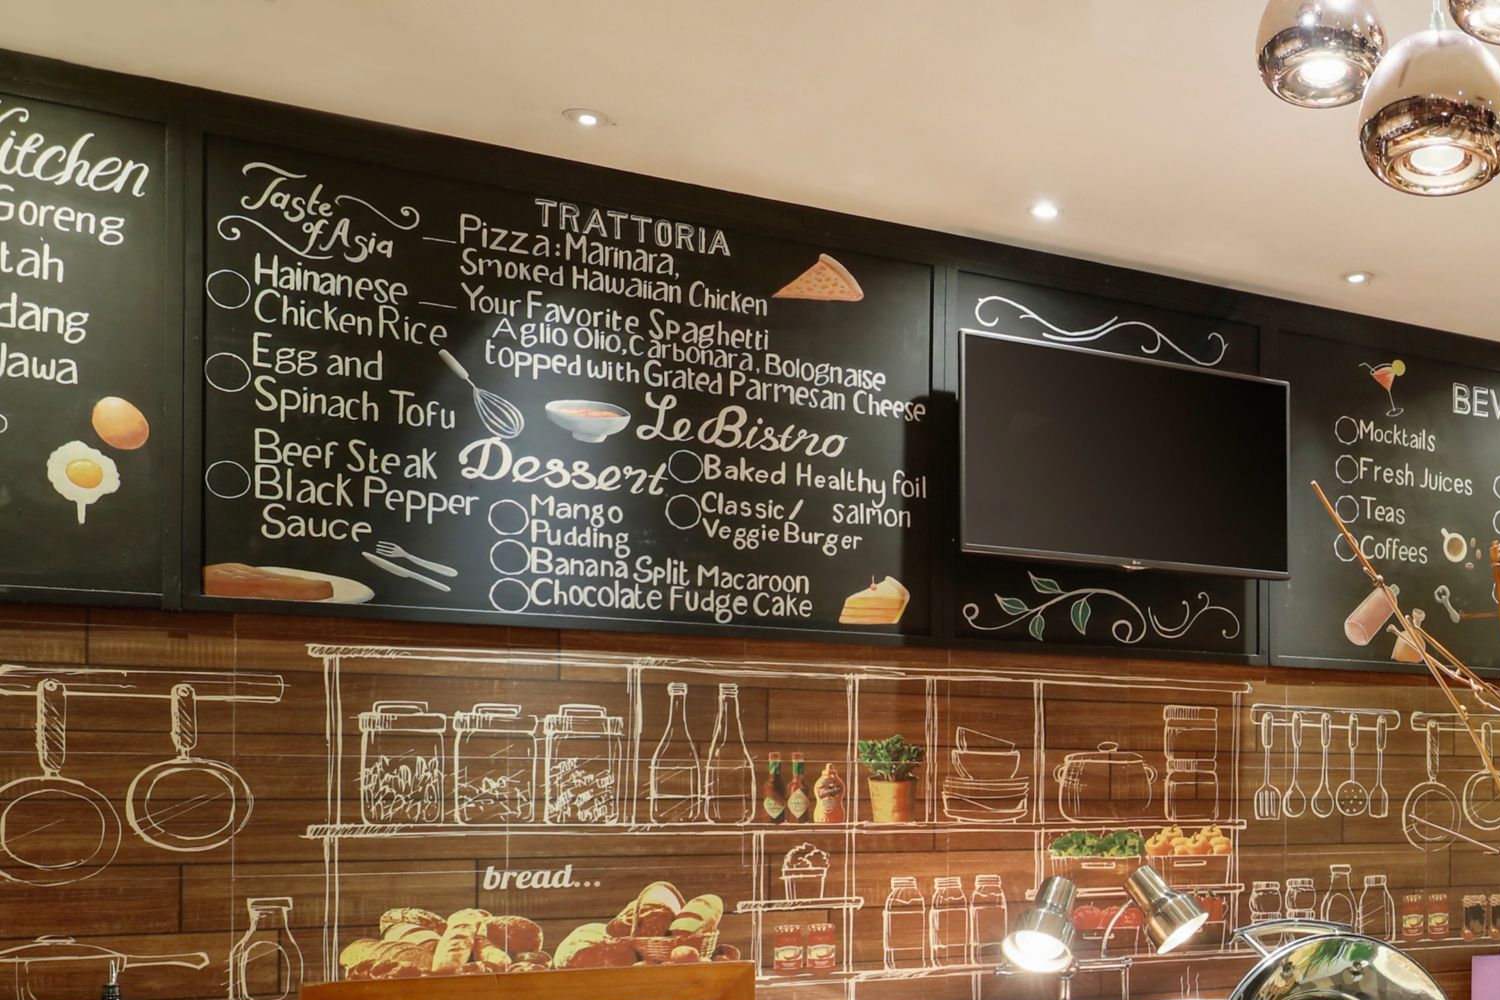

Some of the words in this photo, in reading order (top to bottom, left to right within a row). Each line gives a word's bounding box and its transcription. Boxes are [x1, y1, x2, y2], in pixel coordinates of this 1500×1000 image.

[241, 161, 334, 223] Taste
[302, 218, 329, 255] of
[318, 217, 394, 263] Asia
[534, 197, 731, 258] TRATTORIA
[253, 252, 410, 306] Hainanese
[459, 247, 564, 287] Smoked
[571, 265, 682, 305] Hawaiian
[688, 280, 769, 317] Chicken
[565, 233, 681, 281] Marinara,
[253, 288, 374, 340] Chicken
[378, 303, 449, 347] Rice
[461, 282, 521, 319] Your
[527, 290, 640, 335] Favorite
[648, 307, 769, 352] Spaghetti
[251, 331, 319, 377] Egg
[327, 350, 384, 382] and
[484, 338, 581, 381] topped
[586, 348, 640, 385] with
[643, 362, 723, 397] Grated
[729, 371, 846, 412] Parmesan
[852, 388, 927, 423] Cheese
[491, 317, 568, 348] Aglio
[764, 352, 887, 393] Bolognaise
[254, 375, 380, 425] Spinach
[388, 389, 456, 430] Tofu
[635, 391, 696, 442] Le
[697, 403, 848, 459] Bistro
[253, 427, 340, 471] Beef
[347, 438, 439, 481] Steak
[1359, 418, 1437, 452] Mocktails
[458, 436, 668, 497] Dessert
[703, 453, 788, 487] Baked
[796, 462, 887, 507] Healthy
[1359, 456, 1415, 487] Fresh
[1419, 467, 1473, 496] Juices
[253, 463, 355, 508] Black
[363, 475, 481, 525] Pepper
[530, 494, 624, 529] Mango
[831, 502, 912, 529] salmon
[1360, 495, 1406, 525] Teas
[260, 502, 373, 543] Sauce
[530, 520, 632, 559] Pudding
[702, 516, 779, 552] Veggie
[782, 520, 863, 556] Burger
[530, 547, 630, 580] Banana
[631, 555, 690, 588] Split
[697, 563, 810, 596] Macaroon
[1359, 534, 1428, 565] Coffees
[530, 578, 663, 612] Chocolate
[668, 584, 749, 624] Fudge
[752, 588, 814, 620] Cake
[483, 863, 602, 891] bread...
